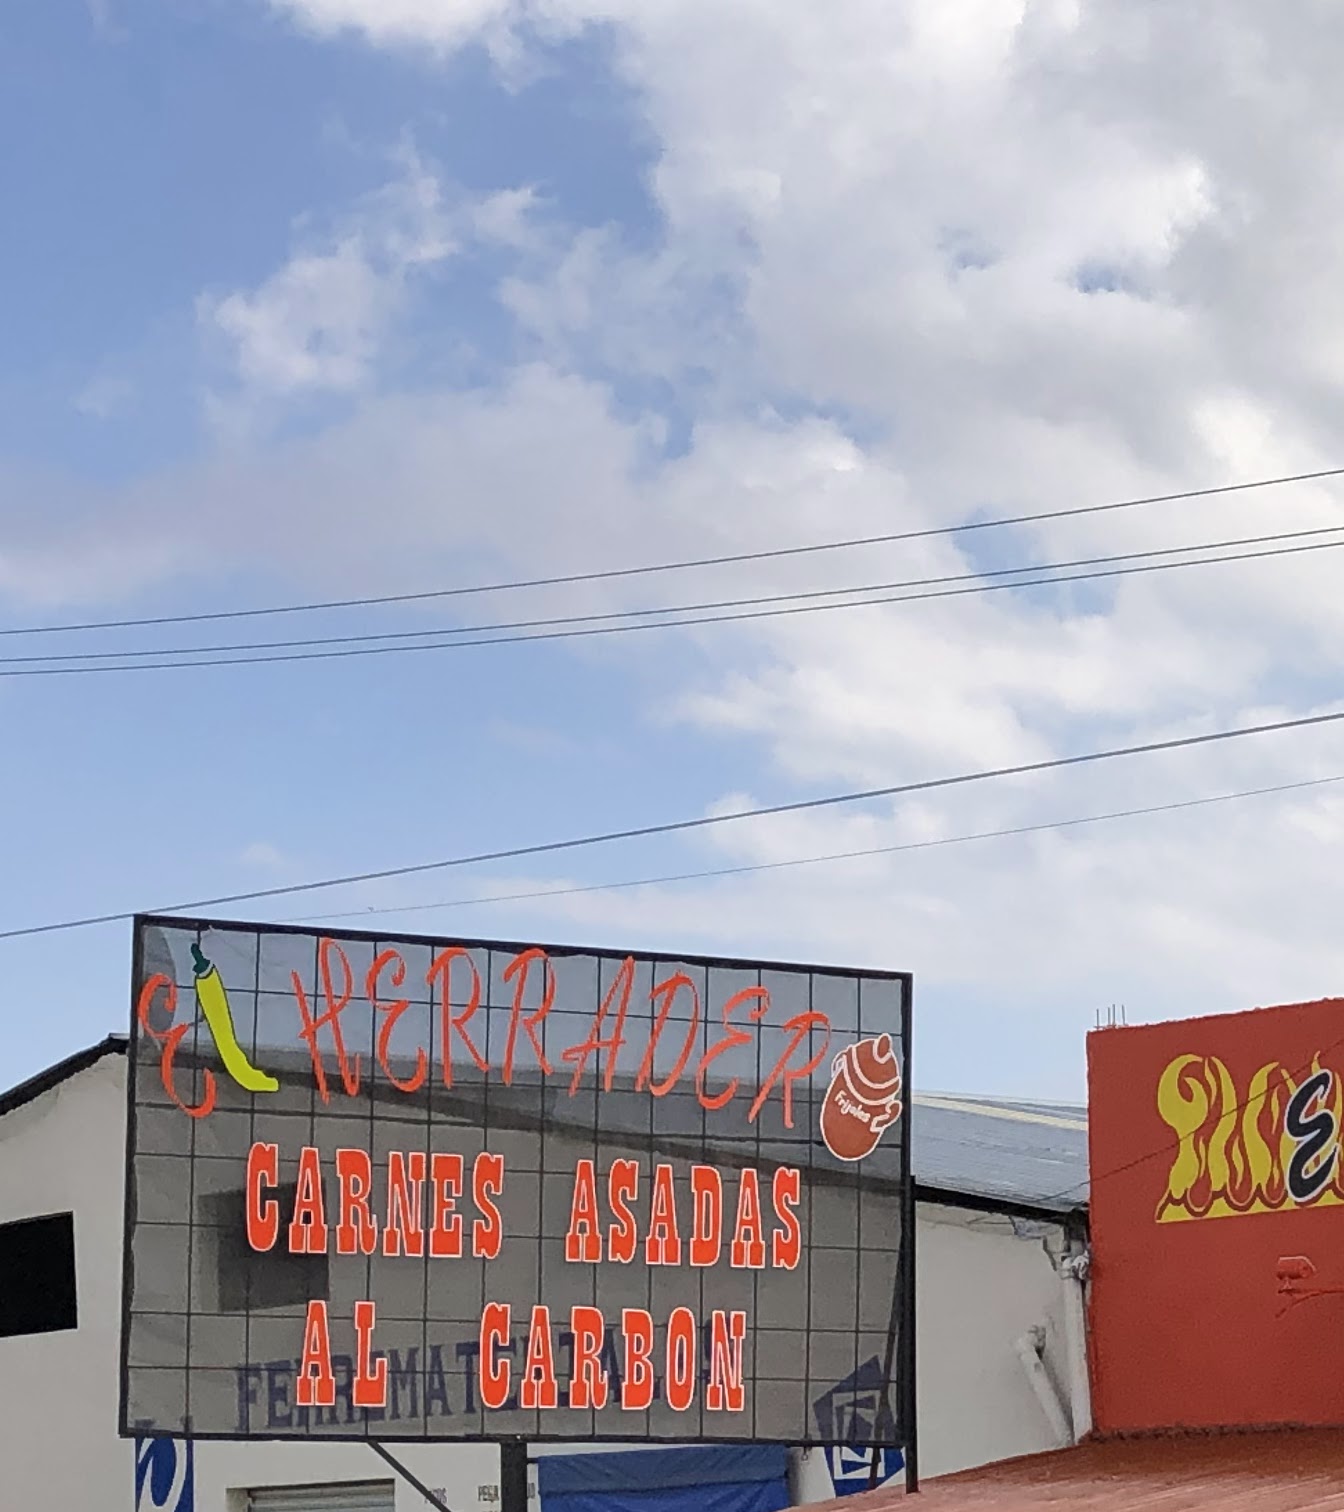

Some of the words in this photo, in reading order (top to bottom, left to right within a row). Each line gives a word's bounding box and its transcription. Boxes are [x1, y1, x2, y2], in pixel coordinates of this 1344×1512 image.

[246, 1142, 504, 1259] CARNES
[566, 1159, 802, 1270] ASADAS
[296, 1300, 388, 1408] AL
[478, 1302, 748, 1412] CARBON
